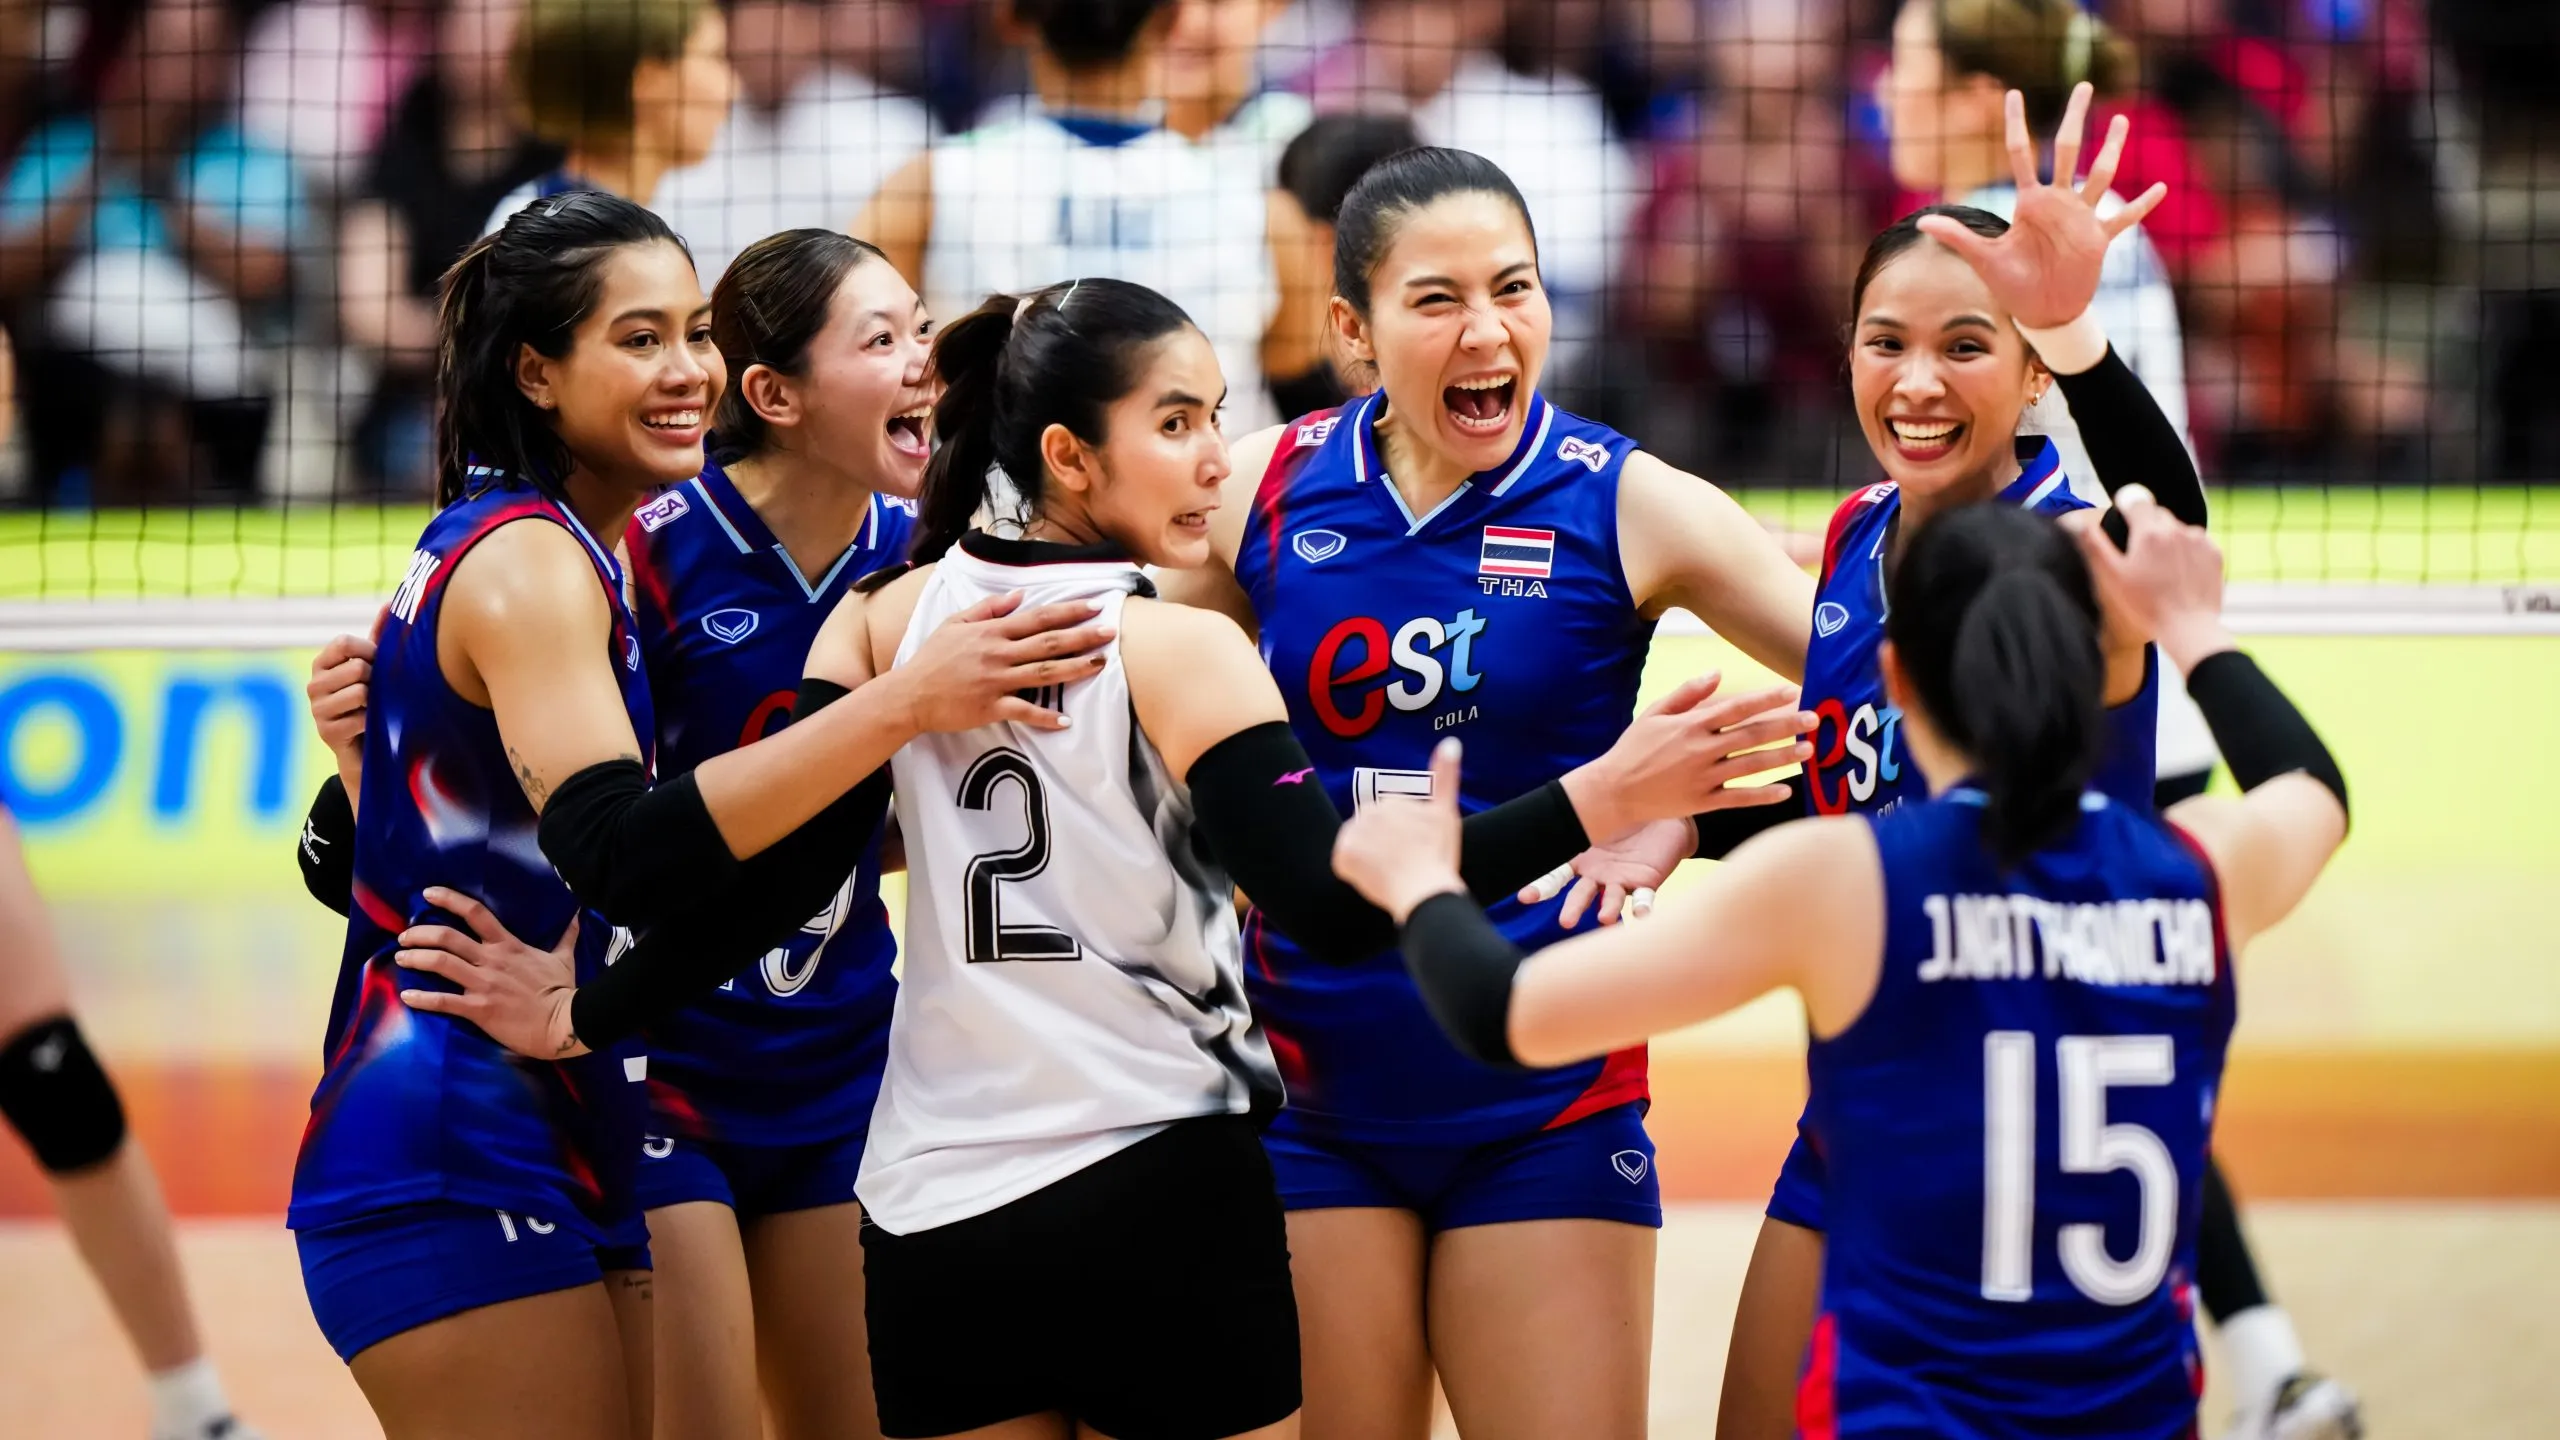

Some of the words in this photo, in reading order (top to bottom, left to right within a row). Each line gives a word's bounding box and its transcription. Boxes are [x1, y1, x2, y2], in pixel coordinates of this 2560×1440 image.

[640, 498, 684, 527] PEA
[1478, 576, 1548, 599] THA
[1307, 607, 1487, 738] est
[1433, 705, 1479, 731] COLA
[1806, 698, 1905, 818] est
[956, 746, 1083, 964] 2
[1980, 1030, 2180, 1306] 15
